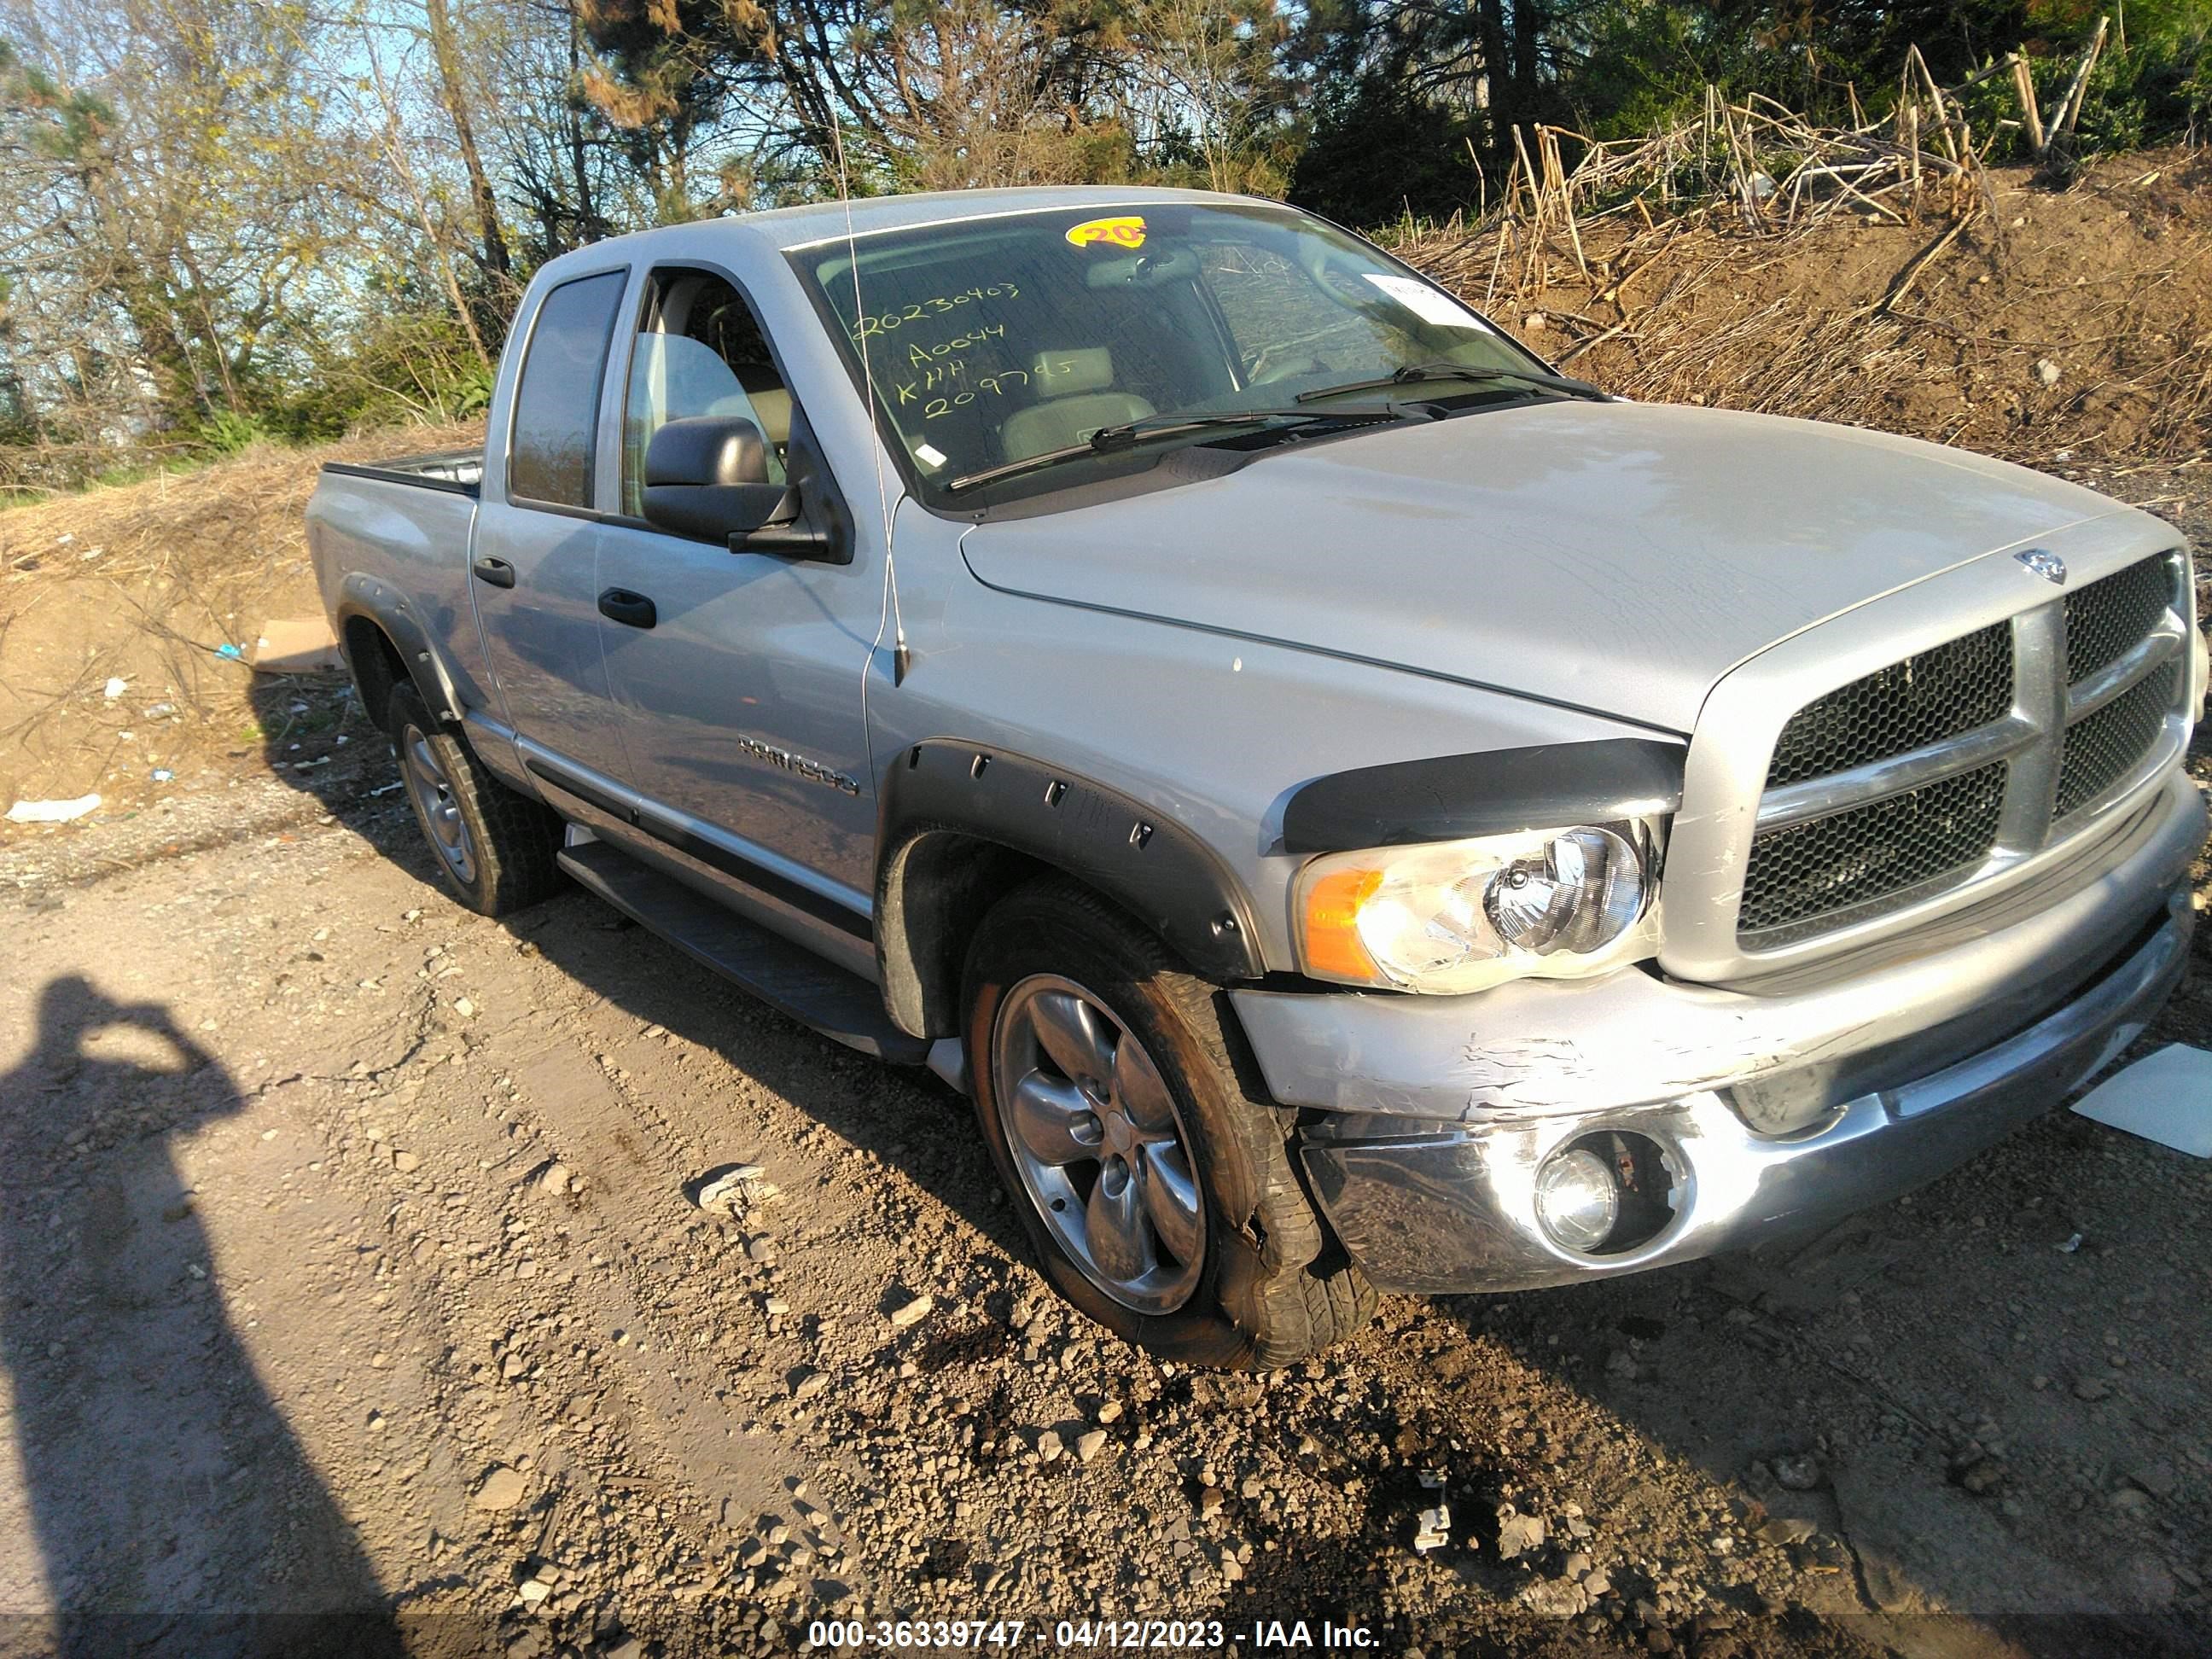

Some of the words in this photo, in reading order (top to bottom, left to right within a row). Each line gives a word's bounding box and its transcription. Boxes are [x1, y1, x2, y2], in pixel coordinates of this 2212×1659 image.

[853, 282, 1019, 341] 20230403
[909, 324, 1004, 369] A0044
[737, 734, 792, 770] RAM
[793, 754, 859, 797] 1500
